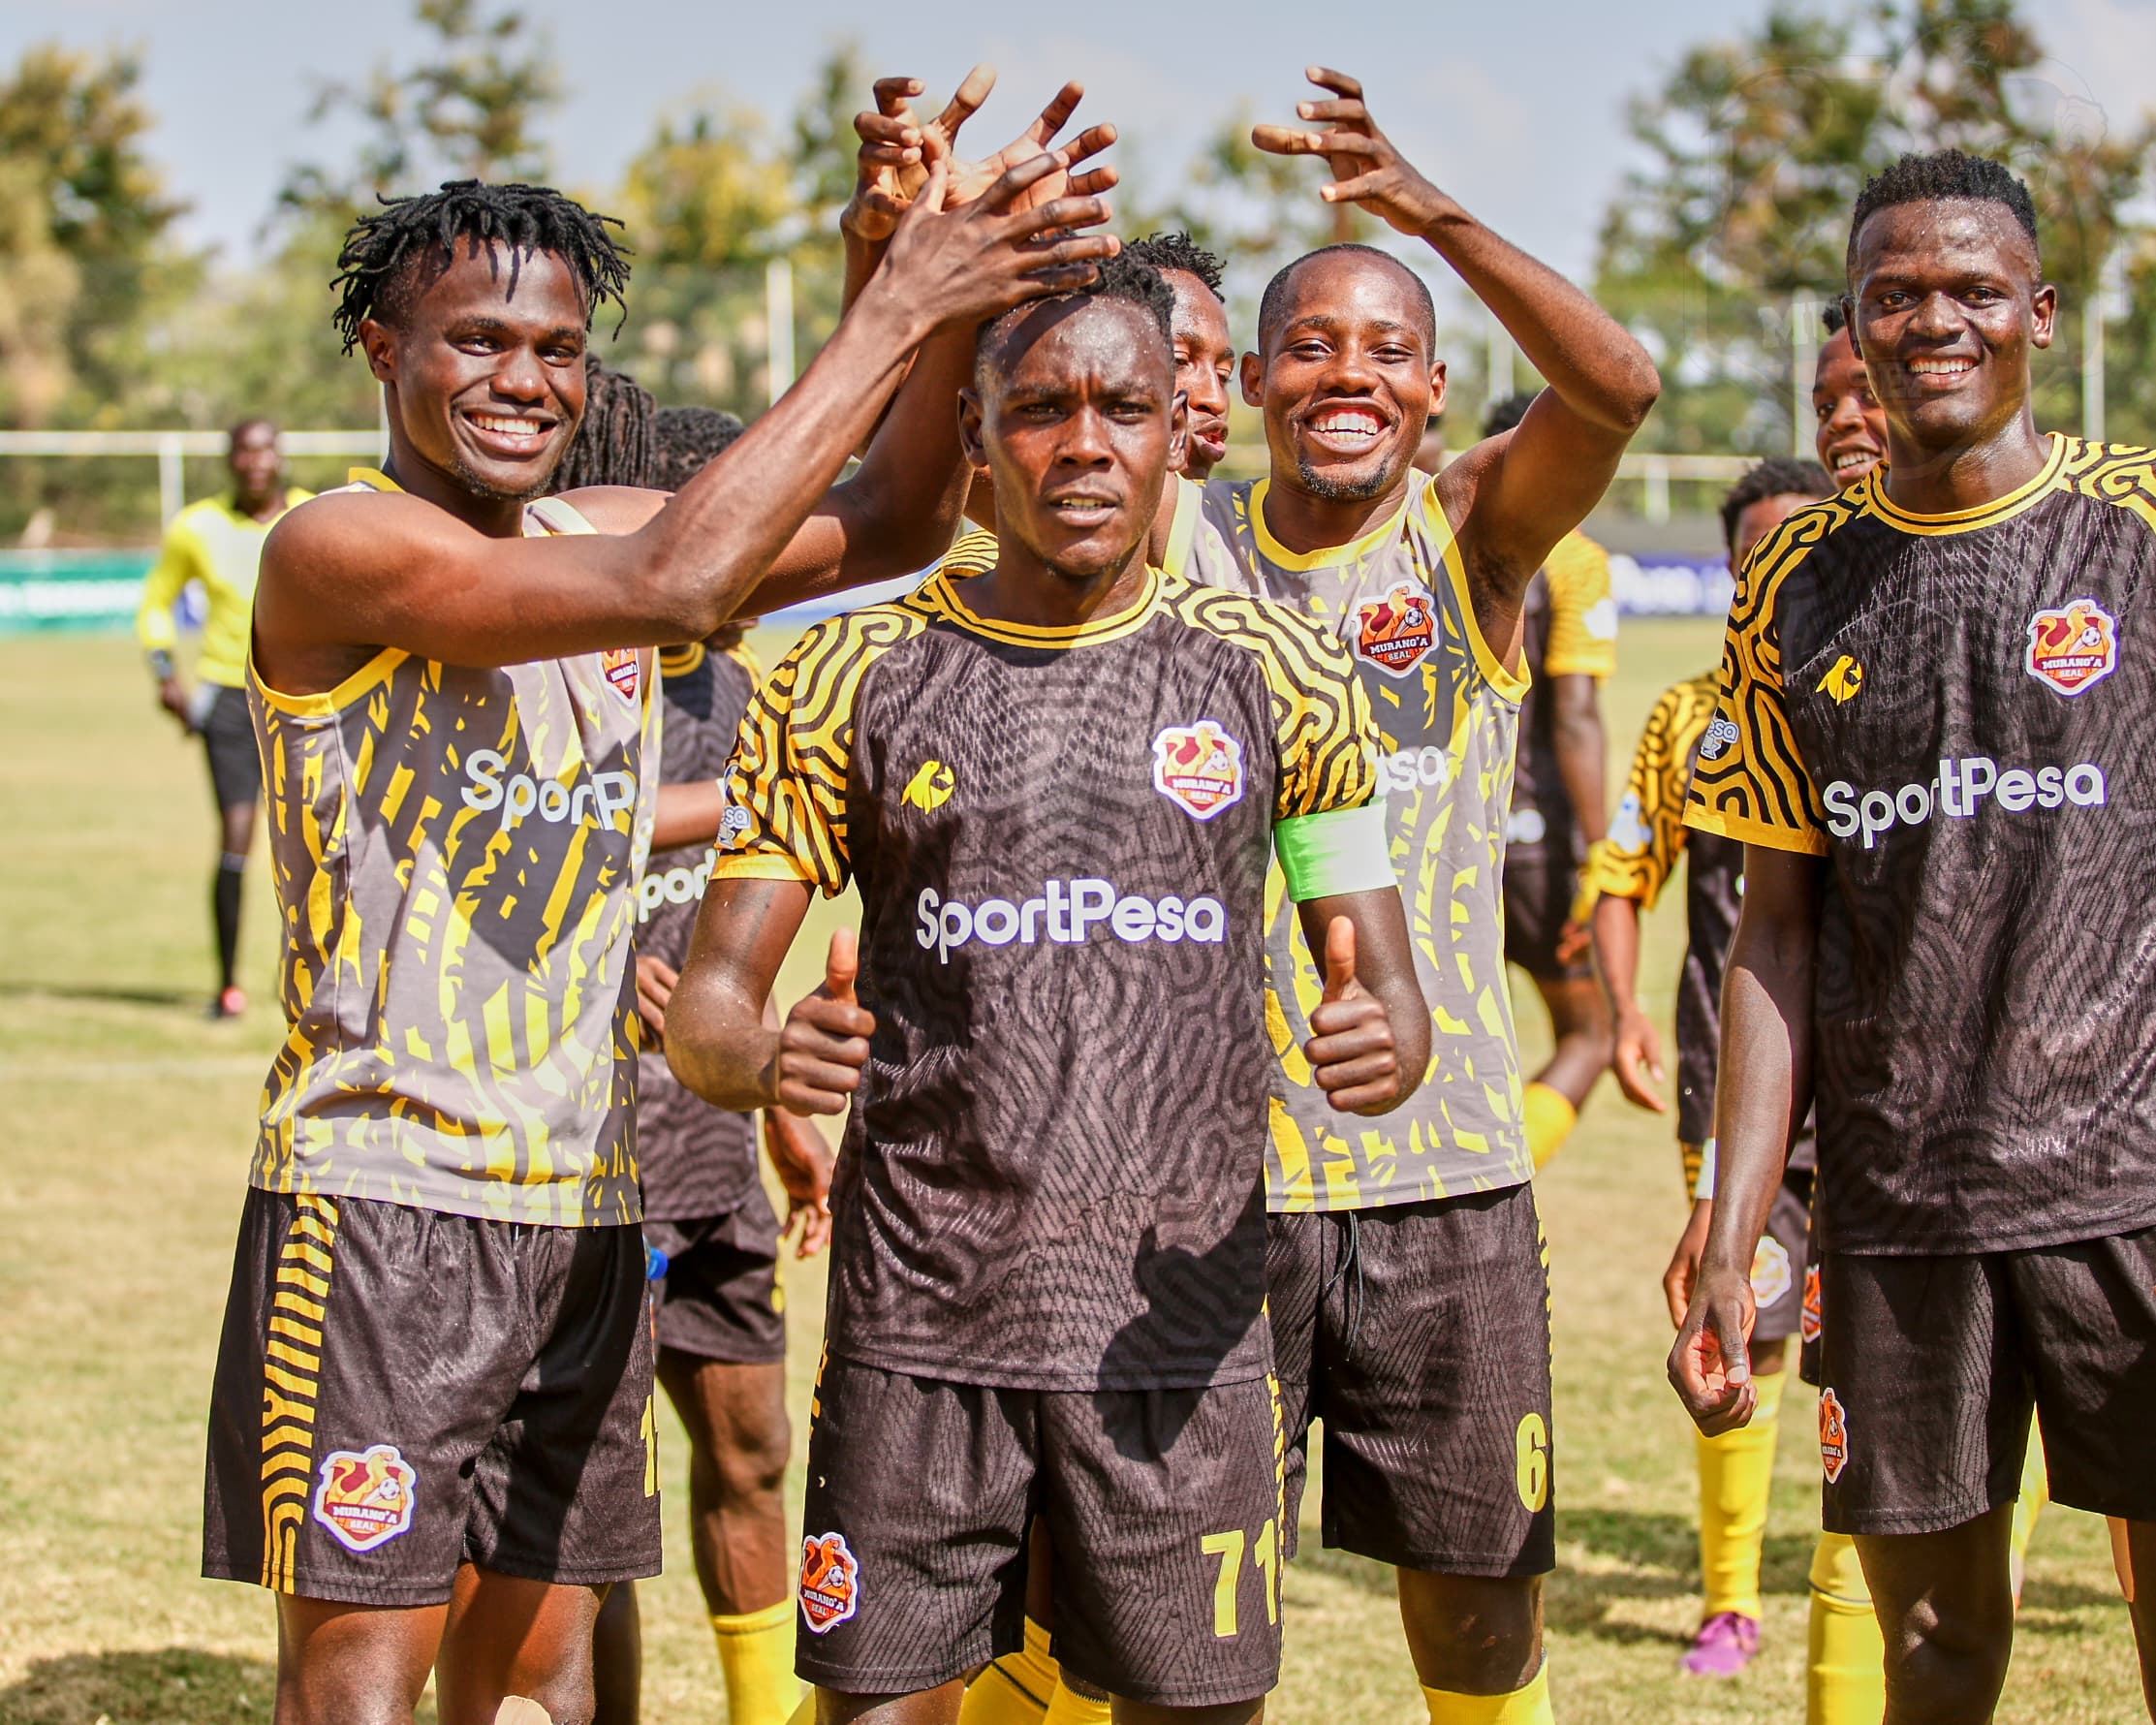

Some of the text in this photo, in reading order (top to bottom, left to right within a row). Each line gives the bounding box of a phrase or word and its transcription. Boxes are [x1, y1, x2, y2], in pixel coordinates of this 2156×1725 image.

[1369, 636, 1428, 654] MURANG'A
[2042, 656, 2104, 670] MURANG'A
[1823, 756, 2105, 849] SportPesa
[917, 879, 1225, 964] SportPesa
[1516, 1412, 1547, 1513] 6
[332, 1505, 398, 1524] MURANG'A
[1202, 1519, 1277, 1638] 71
